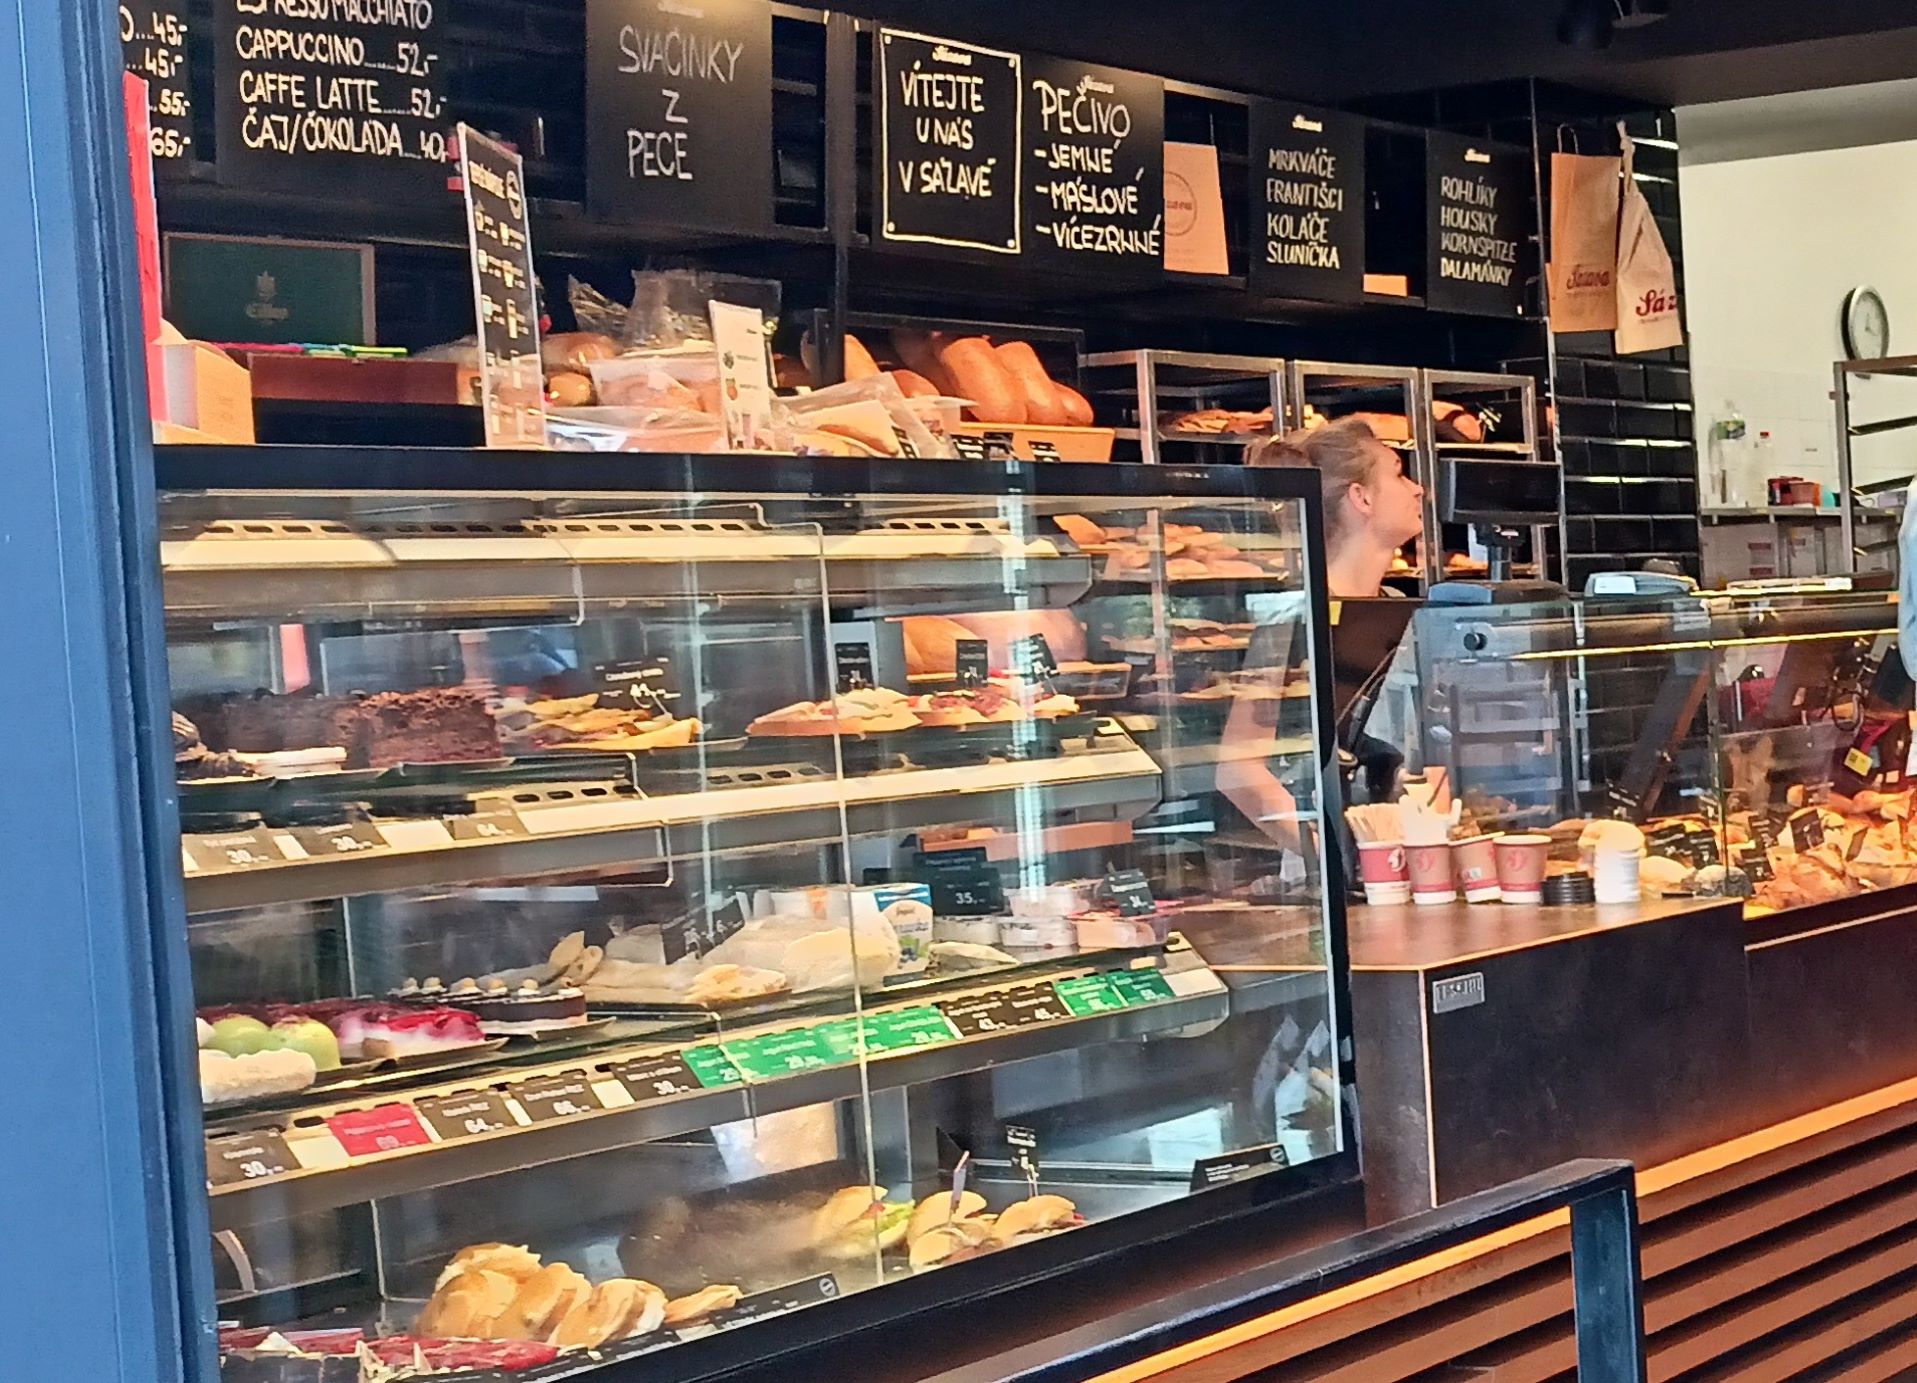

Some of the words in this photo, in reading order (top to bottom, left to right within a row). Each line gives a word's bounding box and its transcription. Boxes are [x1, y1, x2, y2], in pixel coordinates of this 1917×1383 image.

[236, 24, 364, 66] CAPPUCCINO
[240, 70, 306, 109] CAFFE
[316, 75, 382, 114] LATTE
[900, 60, 985, 112] VÍTEJTE
[661, 88, 688, 123] Z
[1032, 80, 1131, 138] PEČIVO
[916, 117, 929, 143] U
[934, 116, 974, 150] NÁS
[627, 129, 693, 180] PECE
[898, 160, 914, 193] V
[1441, 176, 1498, 209] ROHLÍKY
[1267, 211, 1330, 243] KOLÁČE
[1441, 206, 1498, 236] HOUSKY
[1441, 232, 1517, 263] KORNSPITZE
